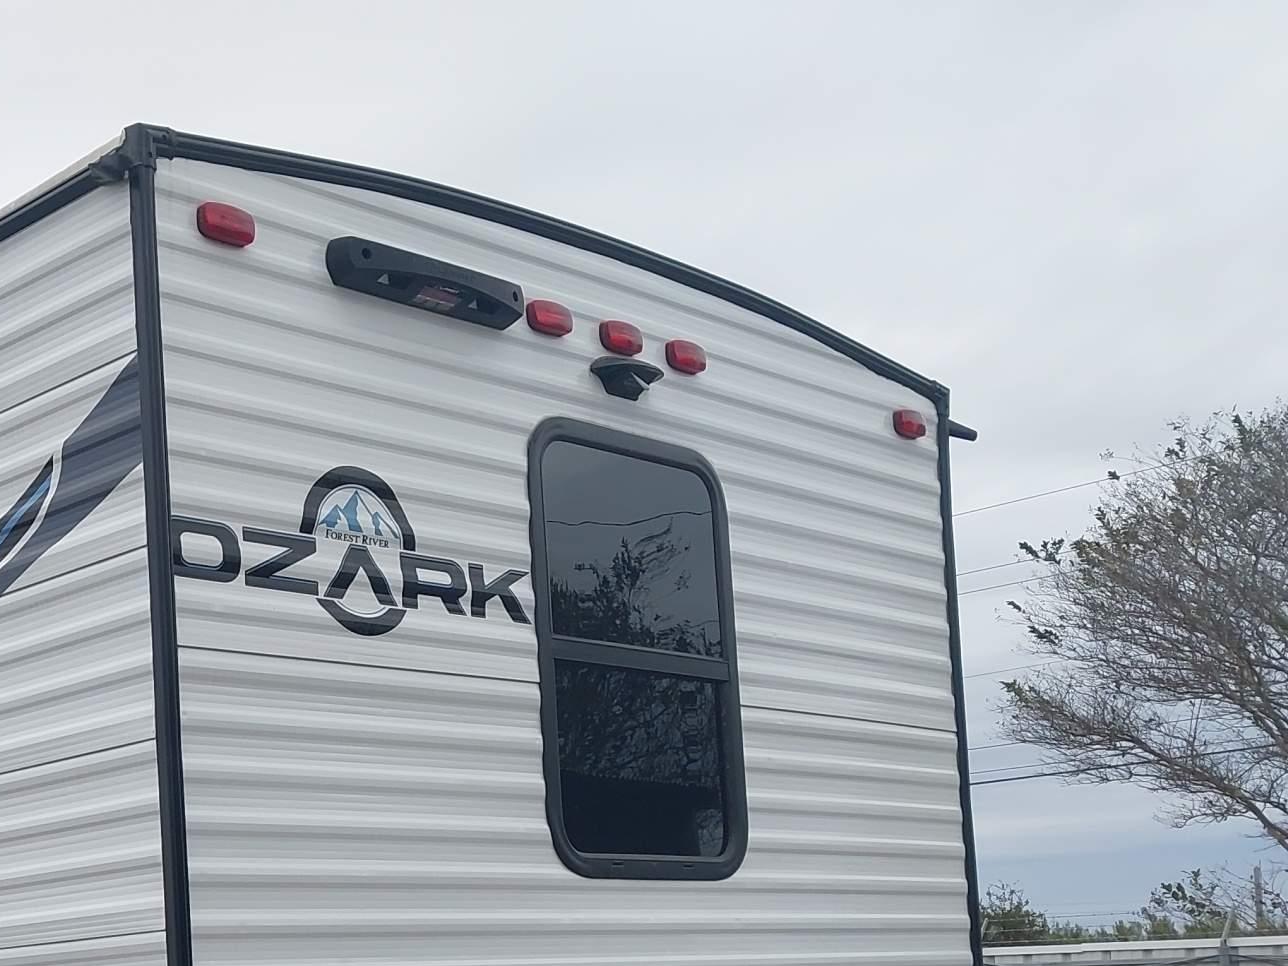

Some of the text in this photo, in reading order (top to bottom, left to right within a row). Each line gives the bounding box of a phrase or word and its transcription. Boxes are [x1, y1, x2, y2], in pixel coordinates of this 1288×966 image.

[172, 514, 532, 625] OZARK
[325, 529, 390, 549] FOREST RIVER
